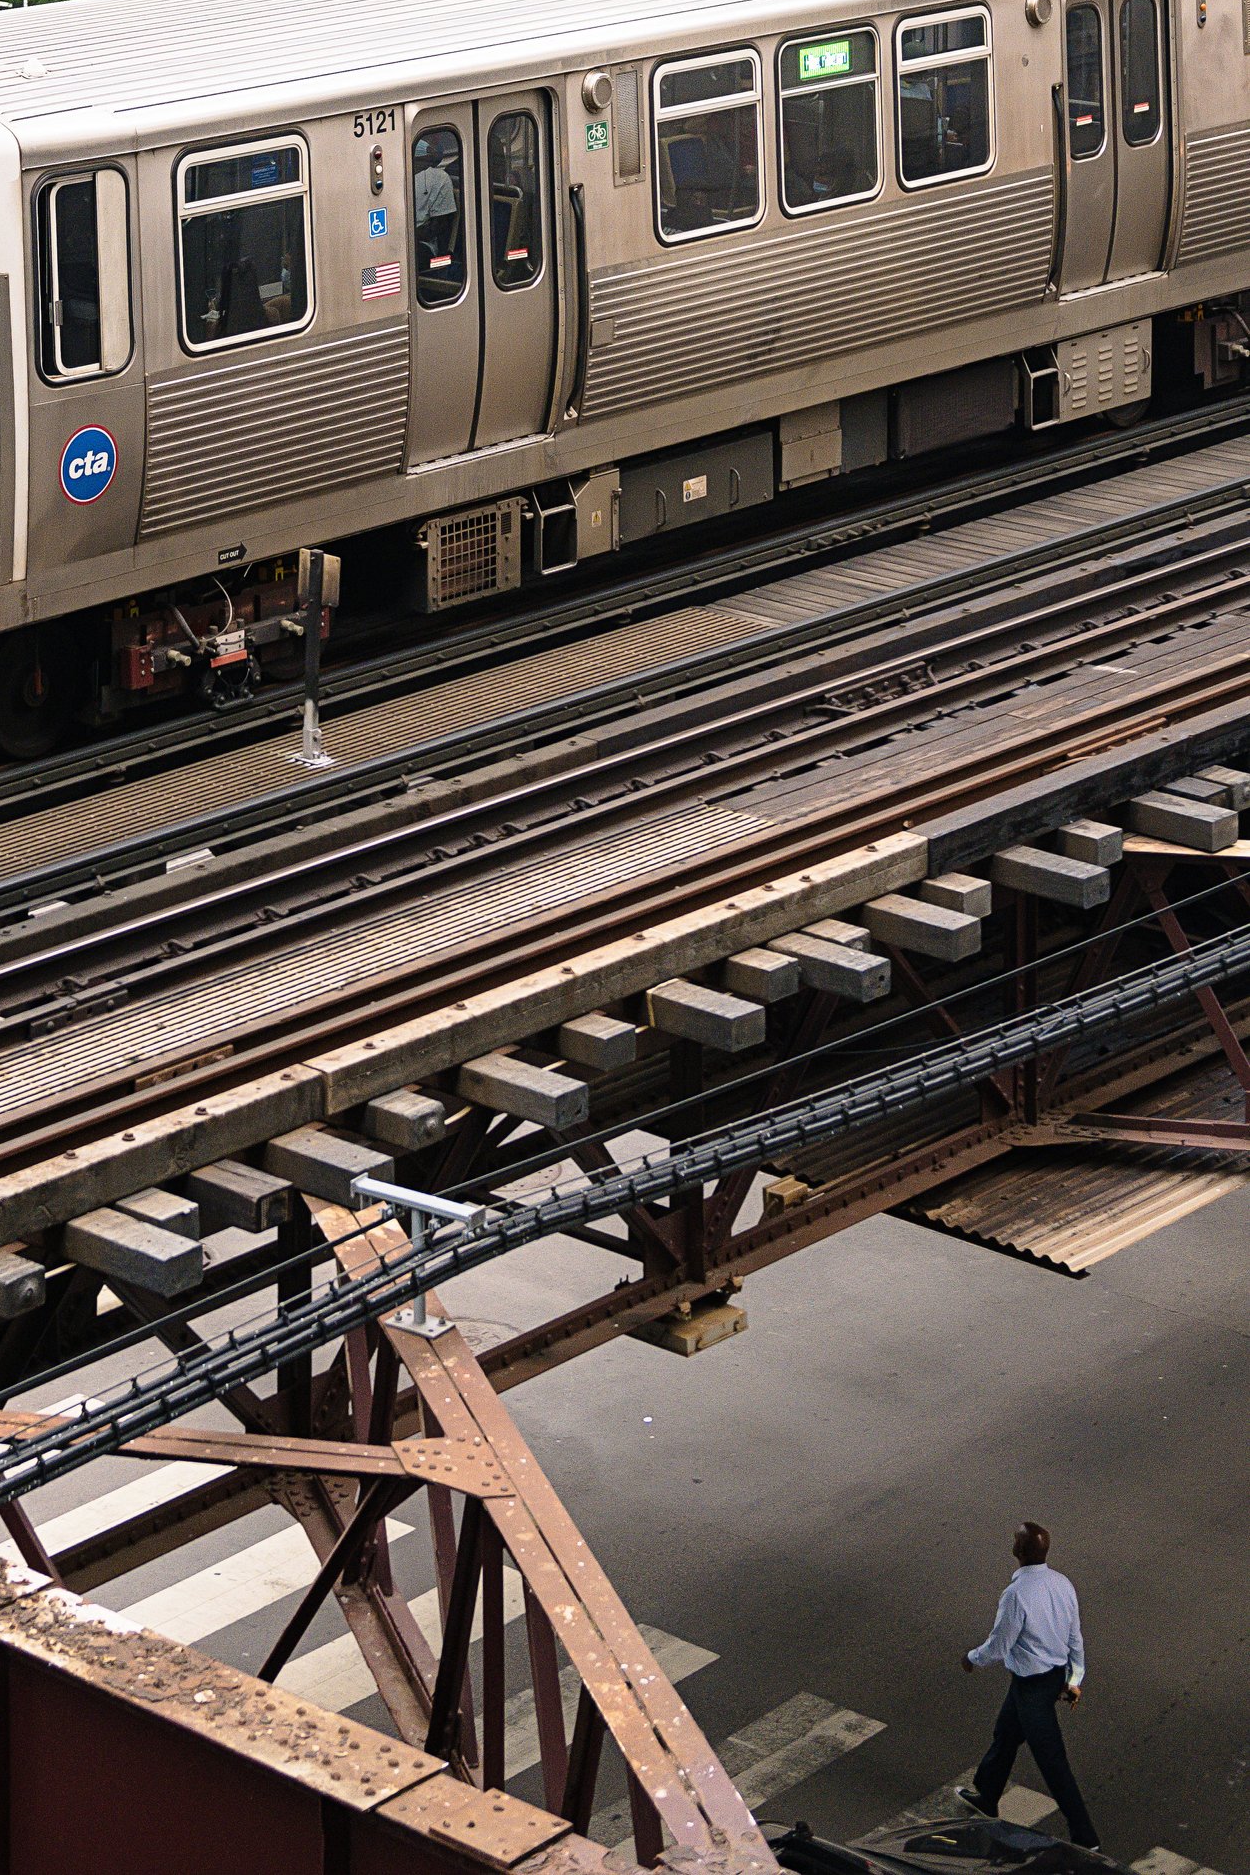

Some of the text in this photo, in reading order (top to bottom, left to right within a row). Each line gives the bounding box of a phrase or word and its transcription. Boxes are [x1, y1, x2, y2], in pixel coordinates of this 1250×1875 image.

[353, 109, 395, 138] 5121
[69, 450, 109, 479] cta
[230, 550, 239, 558] OUT
